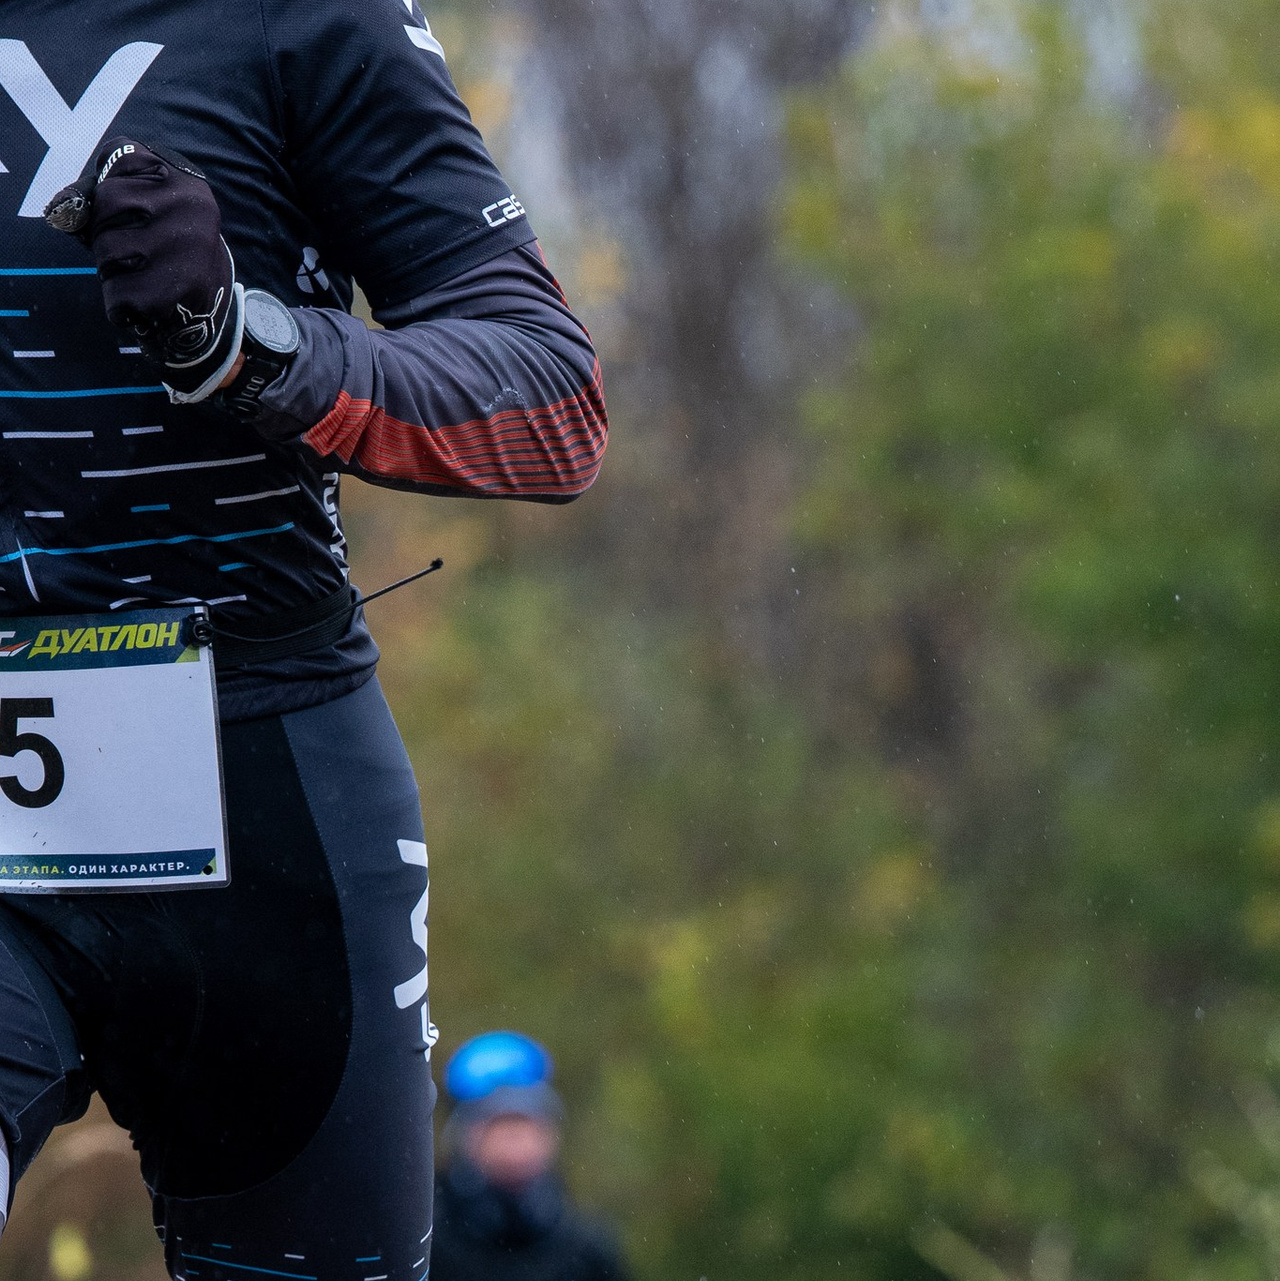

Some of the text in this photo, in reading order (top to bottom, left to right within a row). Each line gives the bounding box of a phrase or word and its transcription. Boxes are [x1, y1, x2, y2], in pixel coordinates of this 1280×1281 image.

[27, 622, 180, 660] ДУАТЛОН
[13, 865, 65, 875] ЭТАПА.
[69, 865, 107, 875] ОДИН
[111, 861, 190, 874] ХАРАКТЕР.
